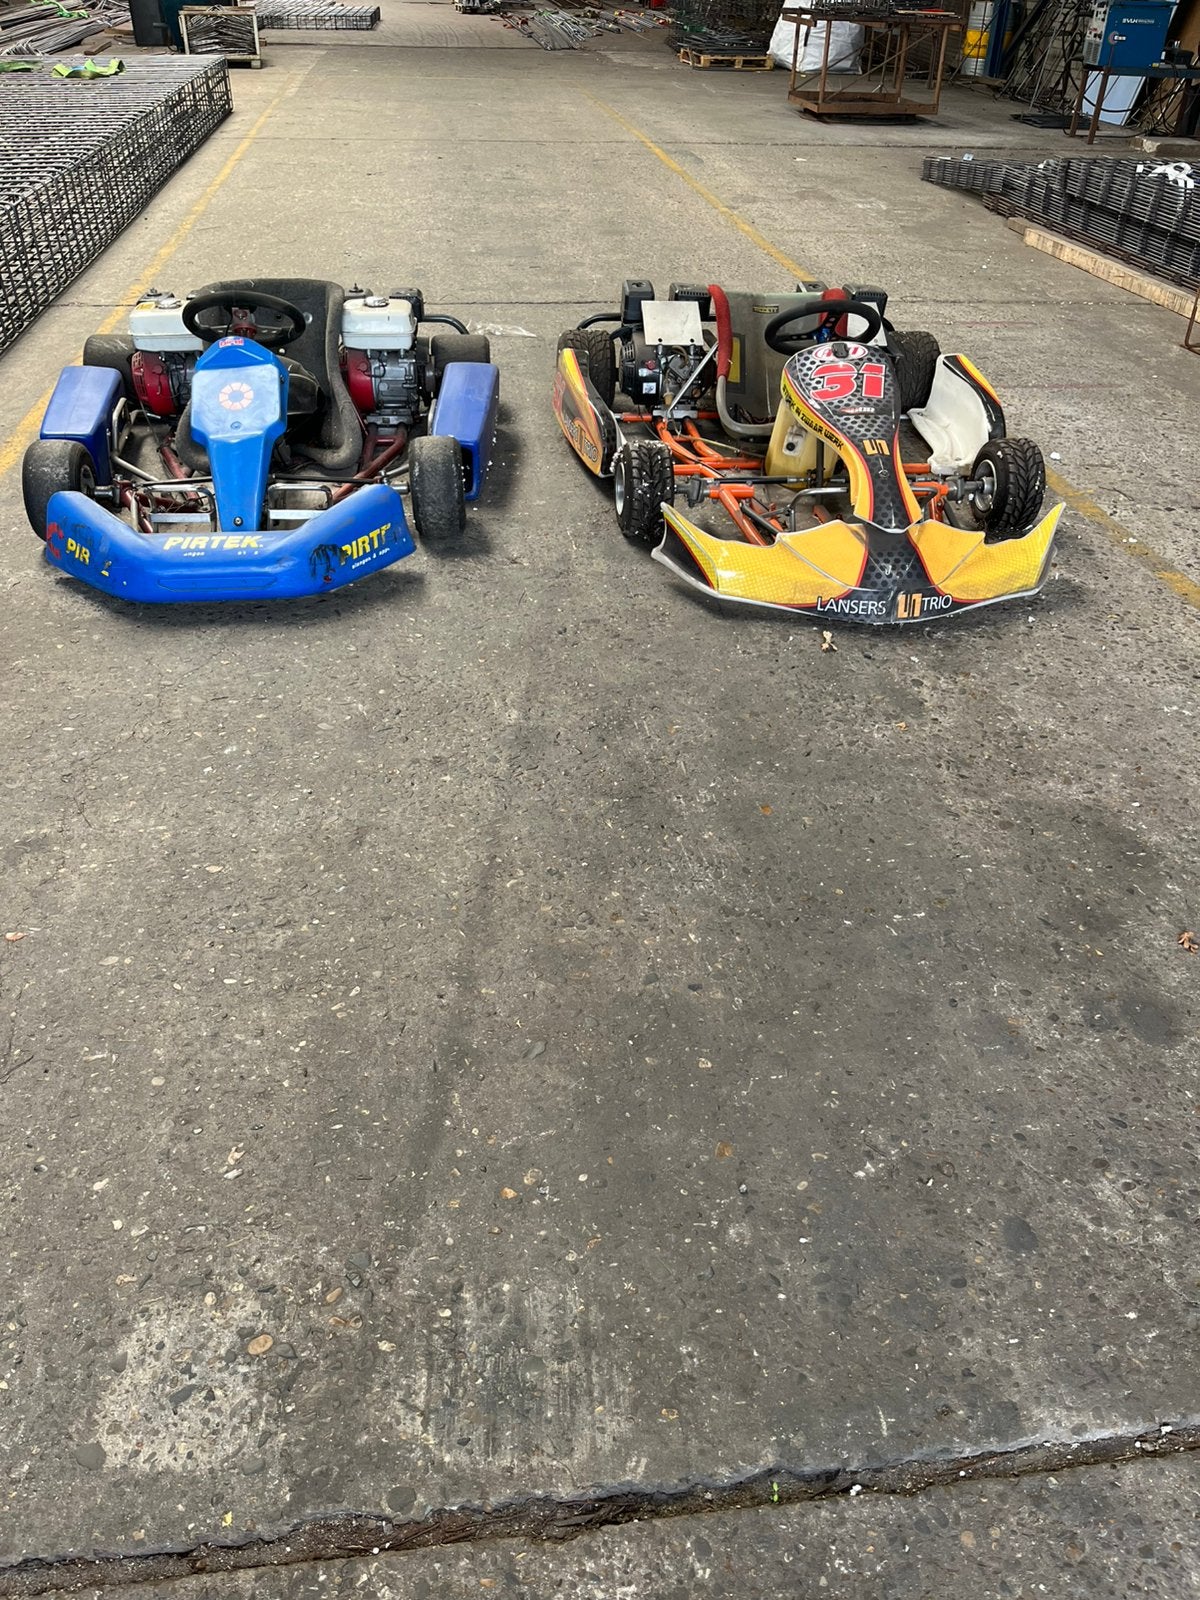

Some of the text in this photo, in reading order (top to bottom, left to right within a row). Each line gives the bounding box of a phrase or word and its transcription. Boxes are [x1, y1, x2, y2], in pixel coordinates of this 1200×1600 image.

[810, 362, 885, 401] 31
[824, 429, 844, 451] WERK
[66, 537, 91, 566] PIR
[817, 597, 886, 615] LANSERS
[922, 594, 952, 611] TRIO
